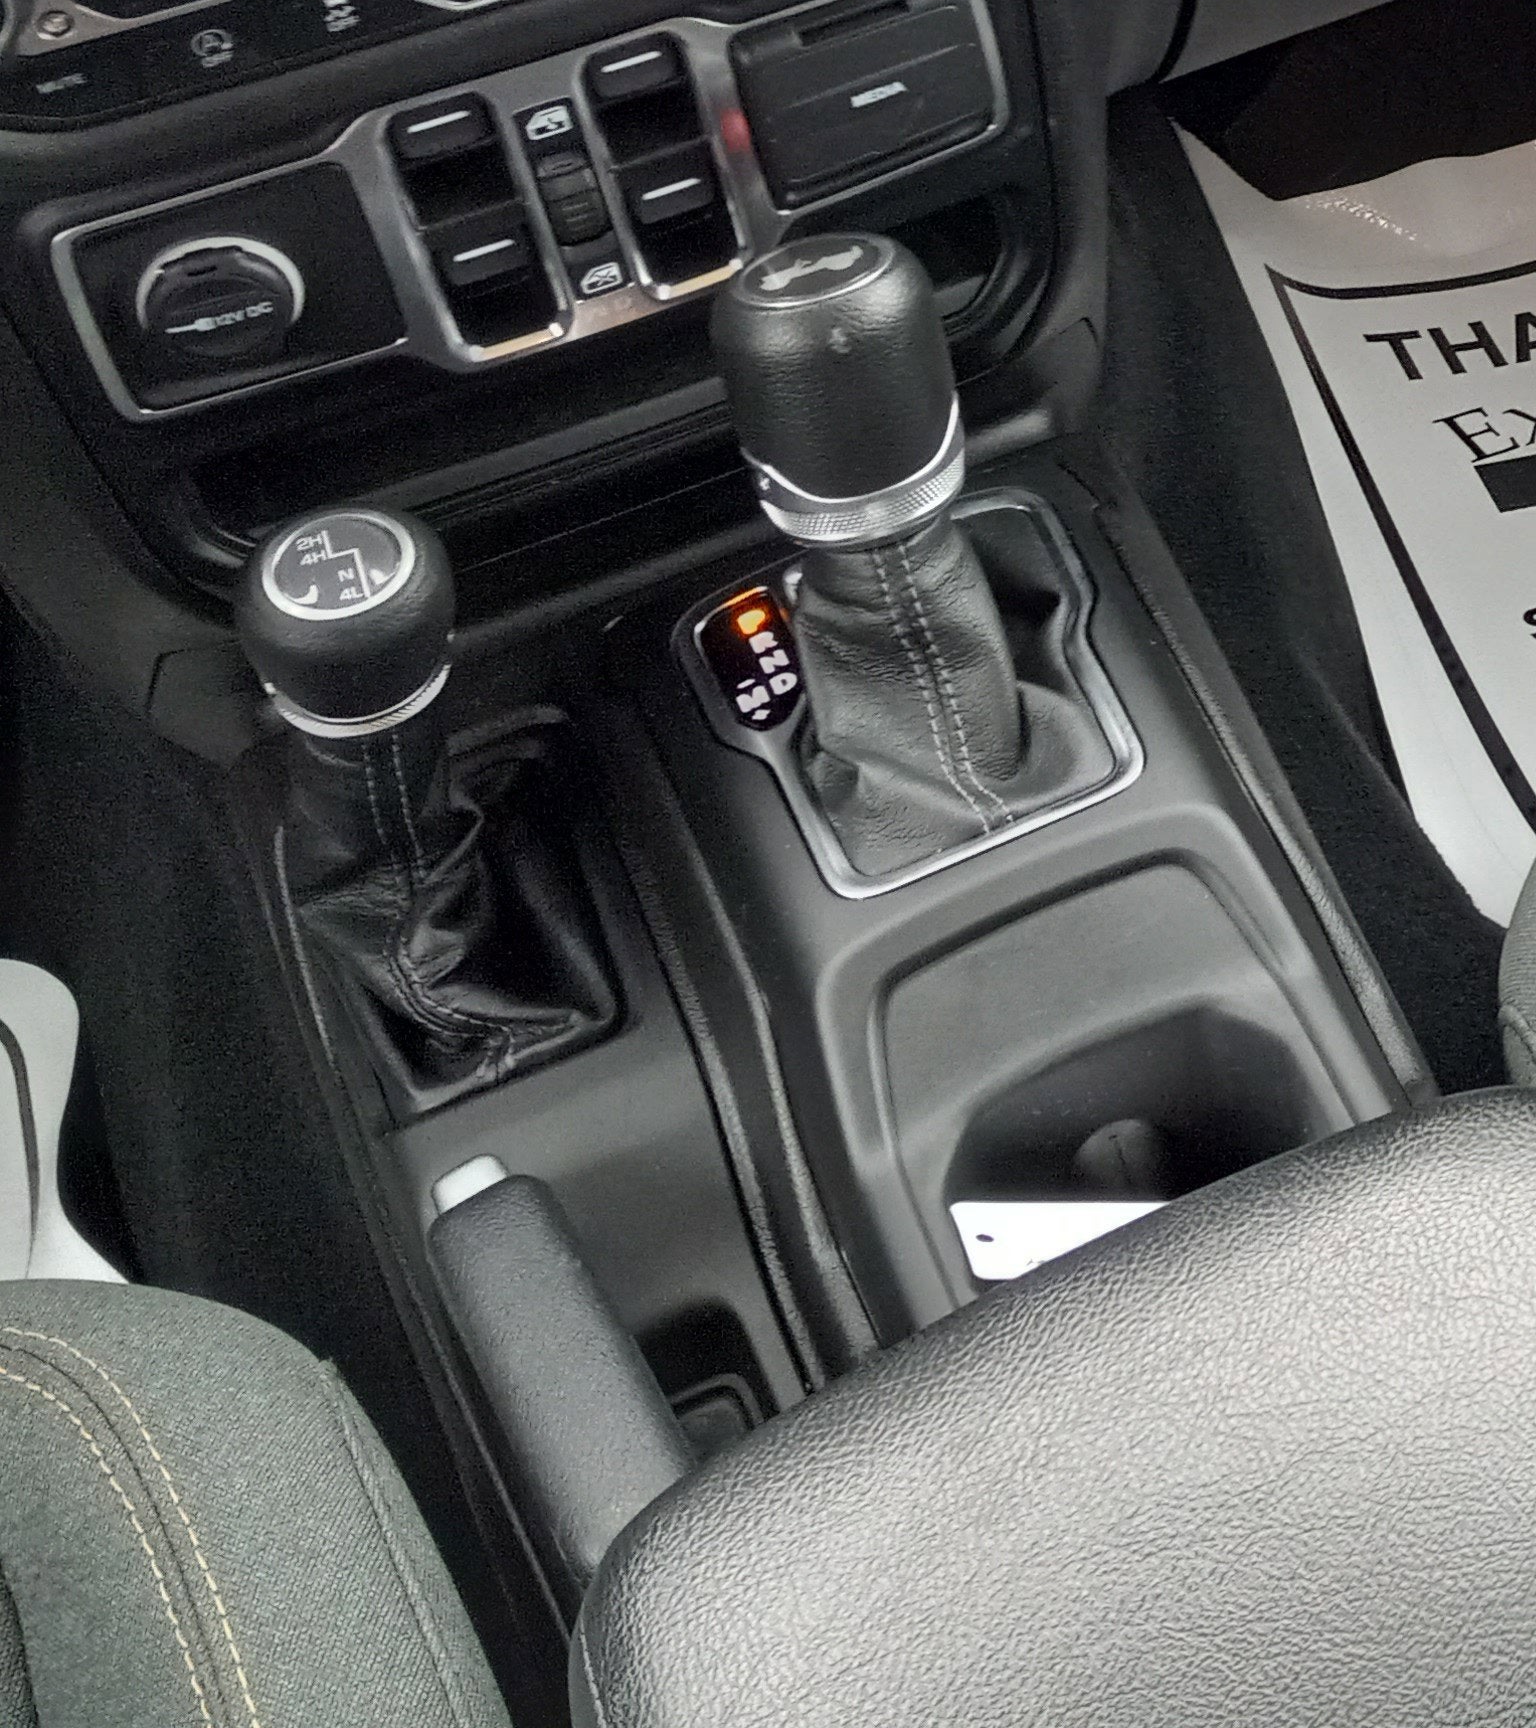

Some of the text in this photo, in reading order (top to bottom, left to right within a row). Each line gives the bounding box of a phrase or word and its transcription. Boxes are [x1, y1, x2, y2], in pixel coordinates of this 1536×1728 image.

[245, 301, 274, 319] DC
[295, 532, 323, 552] 2H
[300, 549, 328, 566] 4H
[336, 567, 355, 583] N
[339, 585, 364, 601] 4L
[768, 672, 798, 695] D
